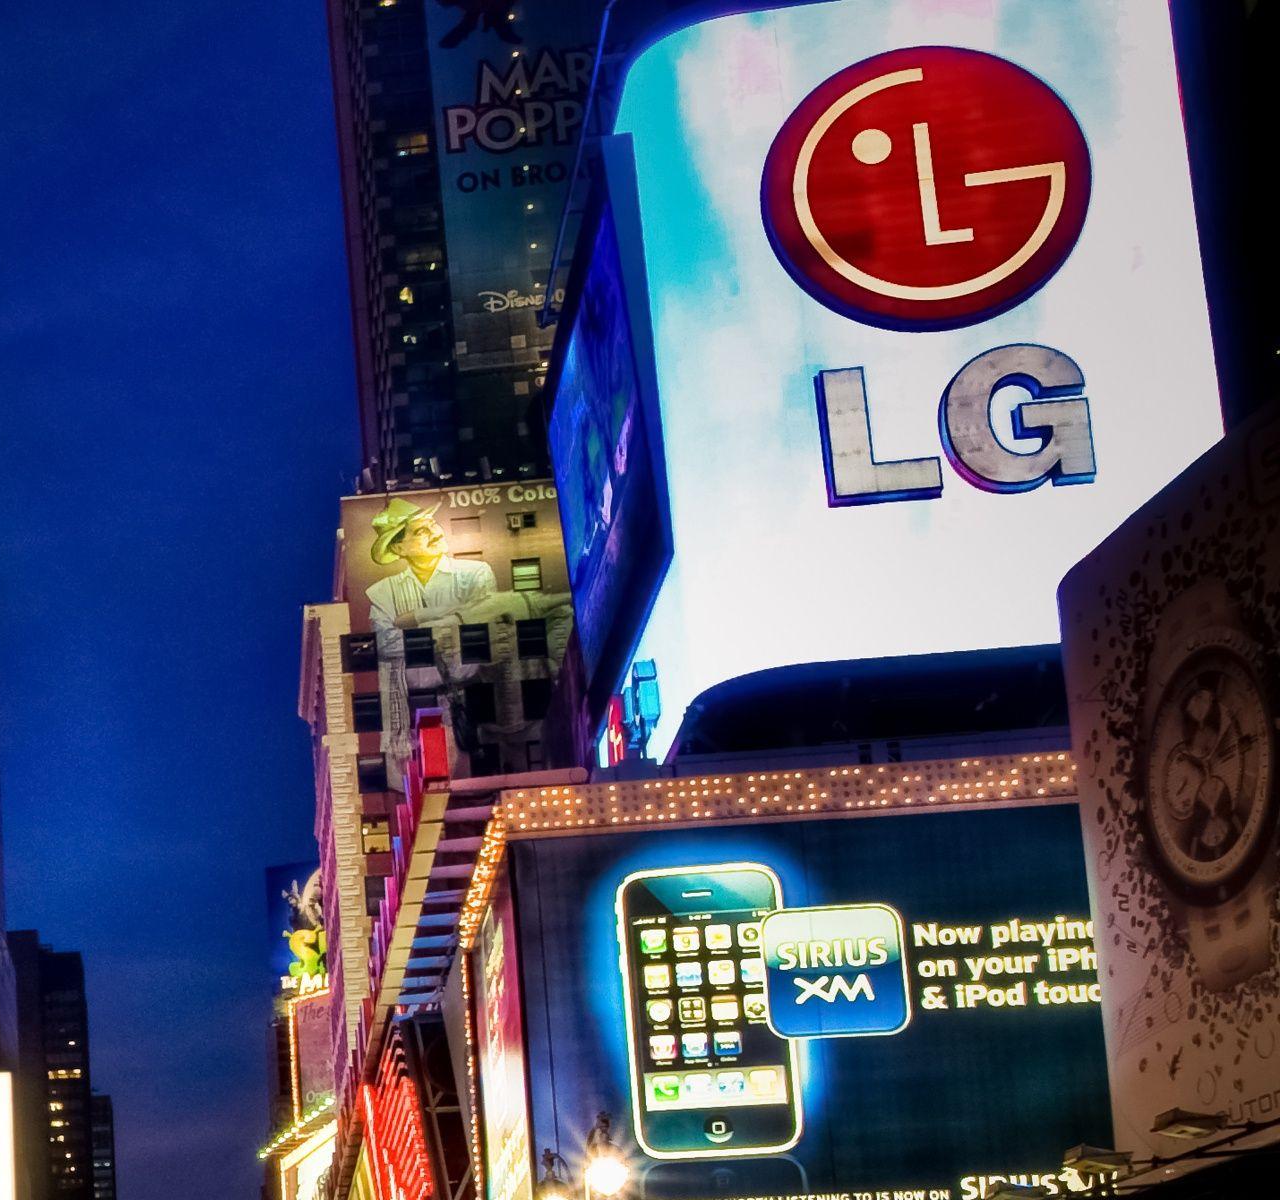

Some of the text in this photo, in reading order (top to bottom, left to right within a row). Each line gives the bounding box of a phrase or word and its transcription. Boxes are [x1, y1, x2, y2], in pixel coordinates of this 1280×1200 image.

[480, 50, 590, 106] MAR
[456, 172, 500, 193] ON
[818, 343, 1097, 506] LG
[448, 485, 557, 508] 100% Colo
[913, 920, 983, 948] Now
[776, 936, 889, 971] SIRIUS
[918, 947, 1099, 983] on your iPh
[792, 975, 876, 1005] XM
[922, 979, 1102, 1010] & iPod touc
